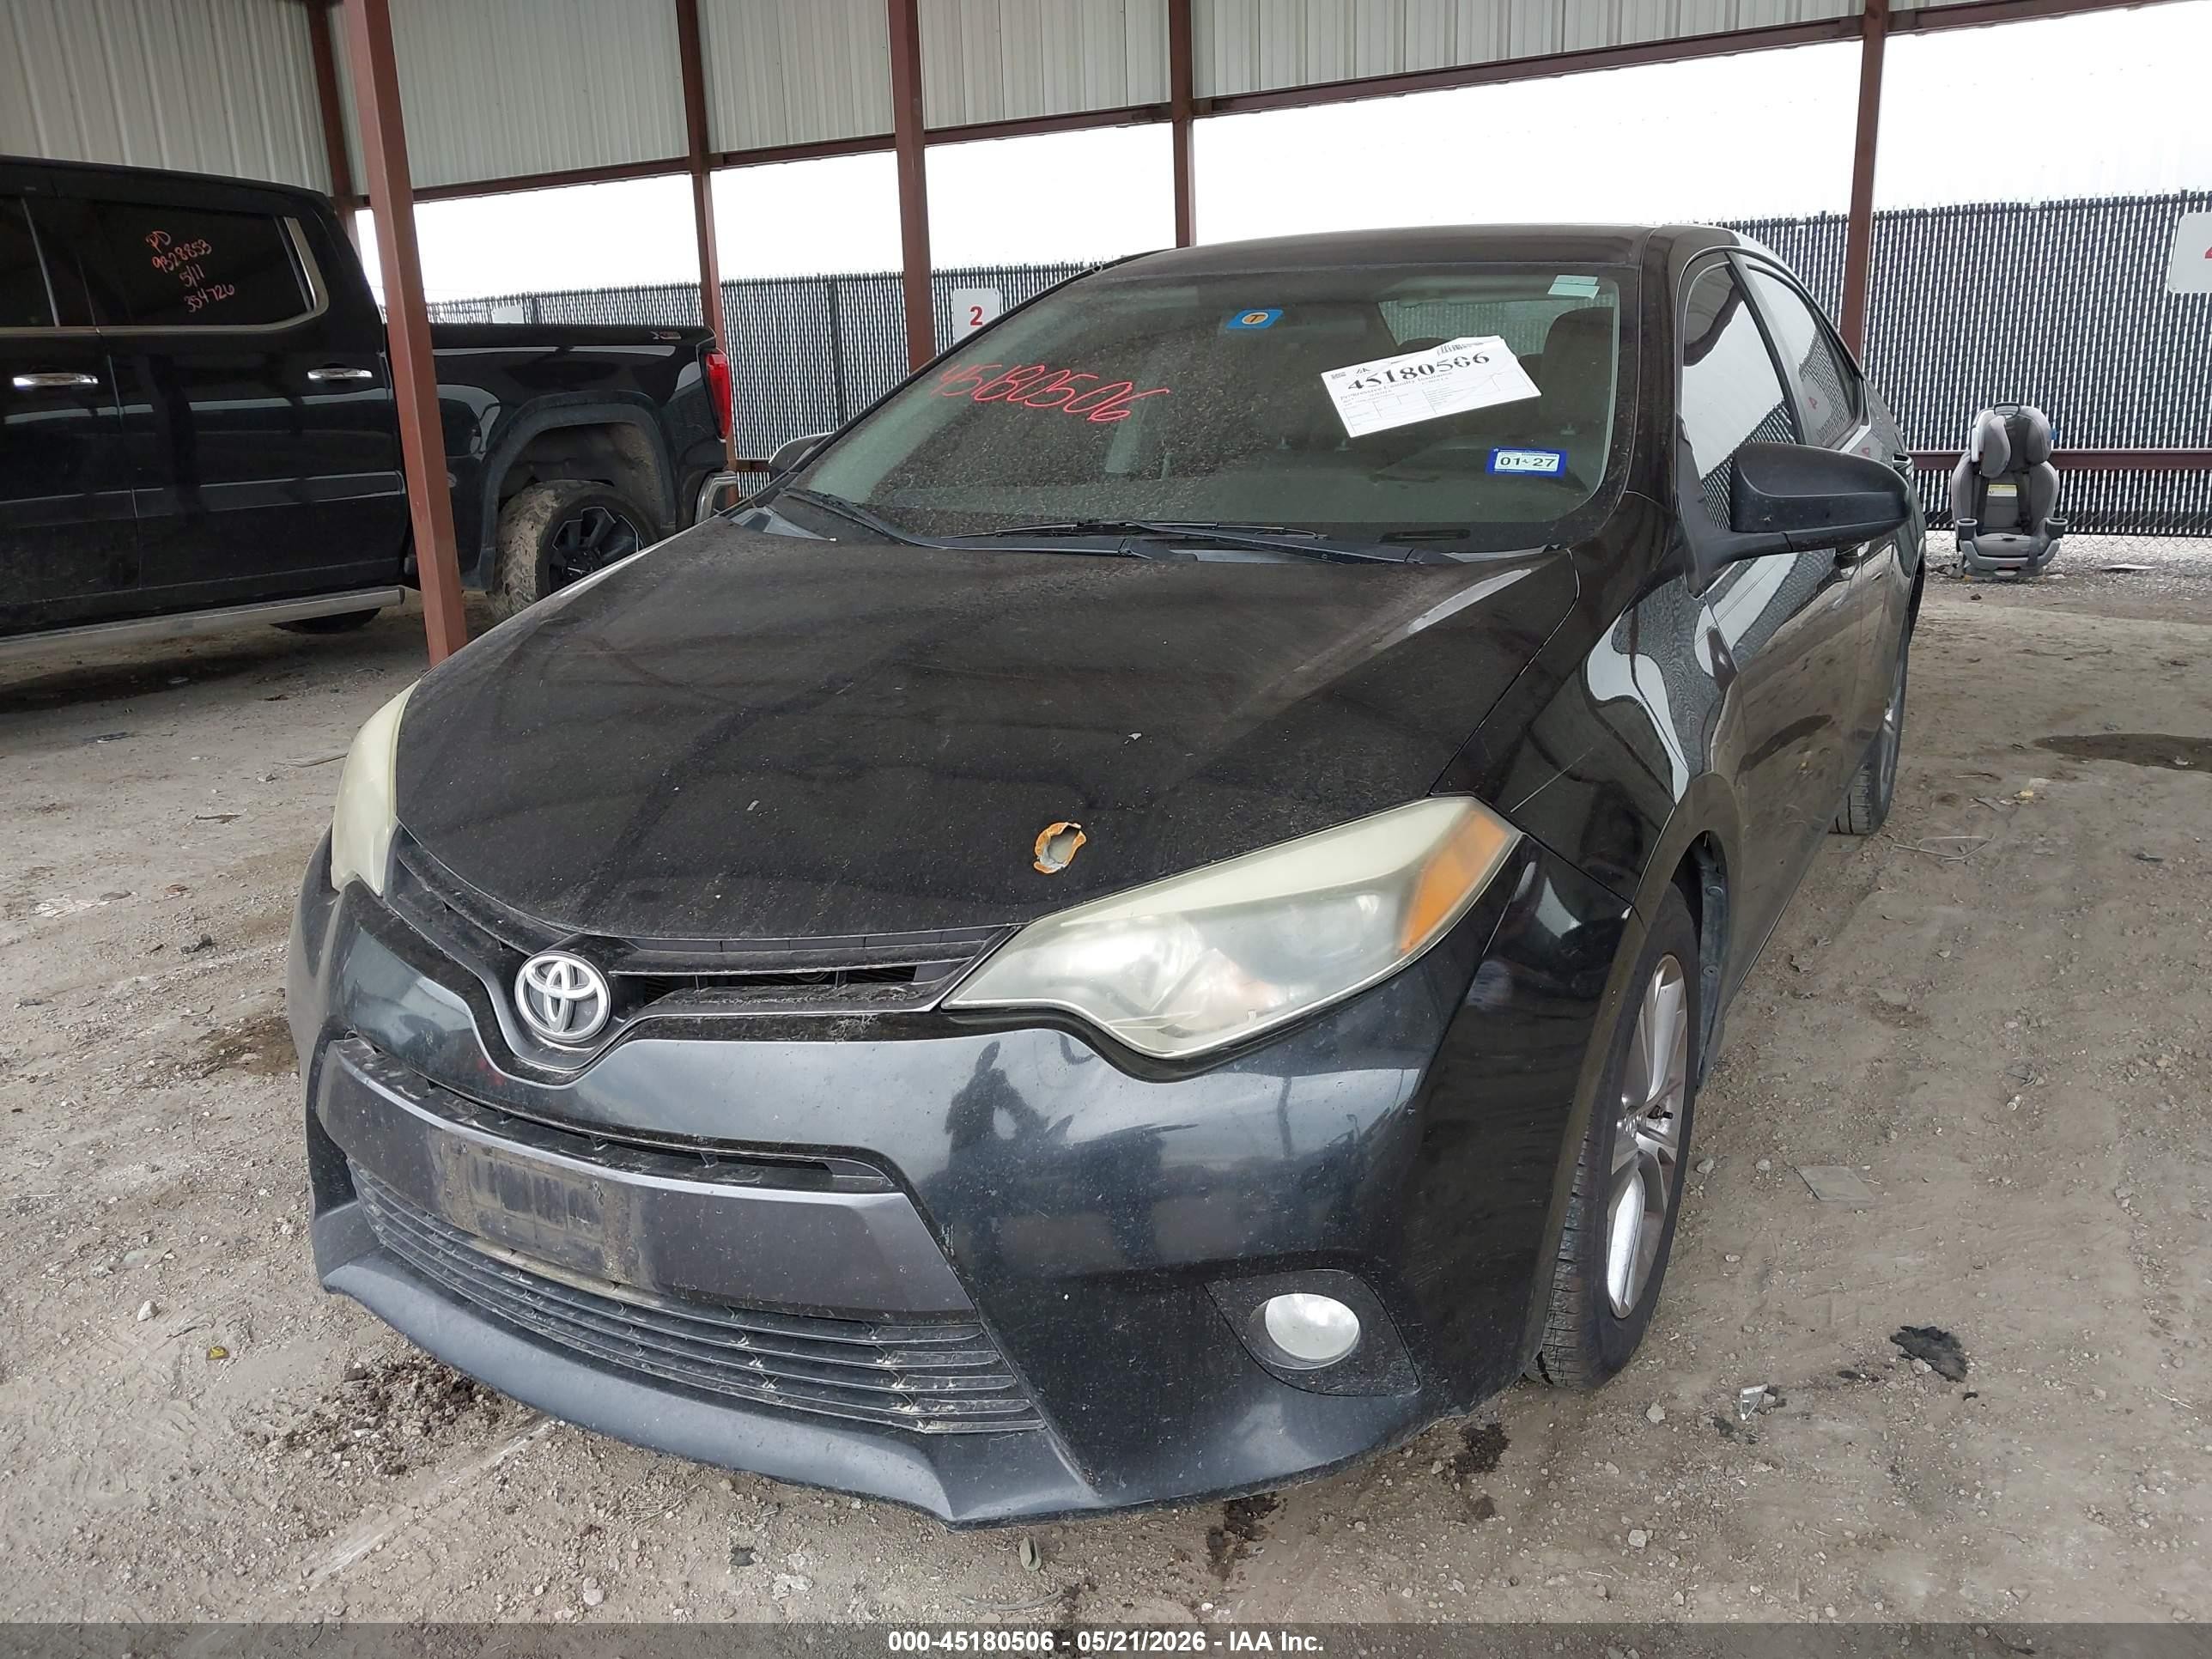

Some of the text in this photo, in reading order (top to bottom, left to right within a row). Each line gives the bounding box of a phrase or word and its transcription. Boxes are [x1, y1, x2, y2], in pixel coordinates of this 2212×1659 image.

[969, 305, 983, 326] 2
[1499, 456, 1557, 468] 01 27
